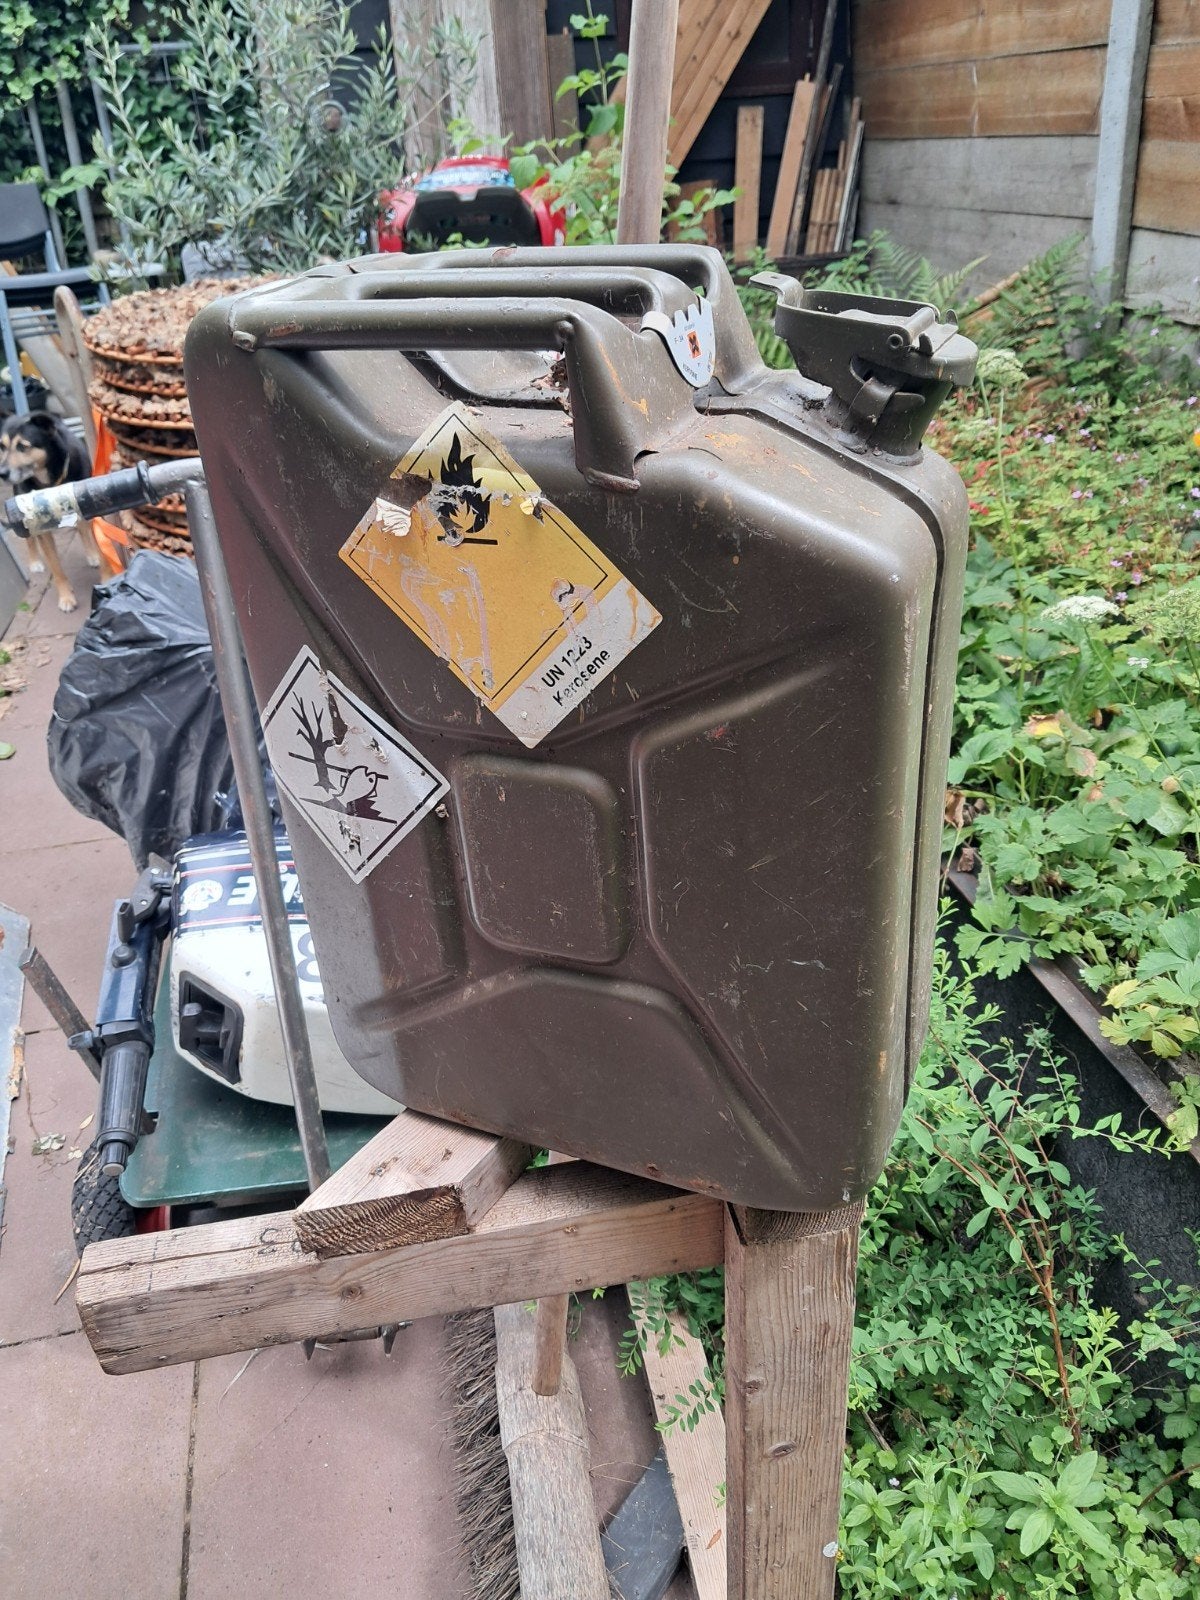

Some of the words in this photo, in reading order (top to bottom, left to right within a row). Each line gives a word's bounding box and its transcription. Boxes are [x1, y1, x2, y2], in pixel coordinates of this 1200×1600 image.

[541, 664, 565, 688] UN
[561, 636, 593, 667] 1223
[552, 649, 611, 707] Kerosene
